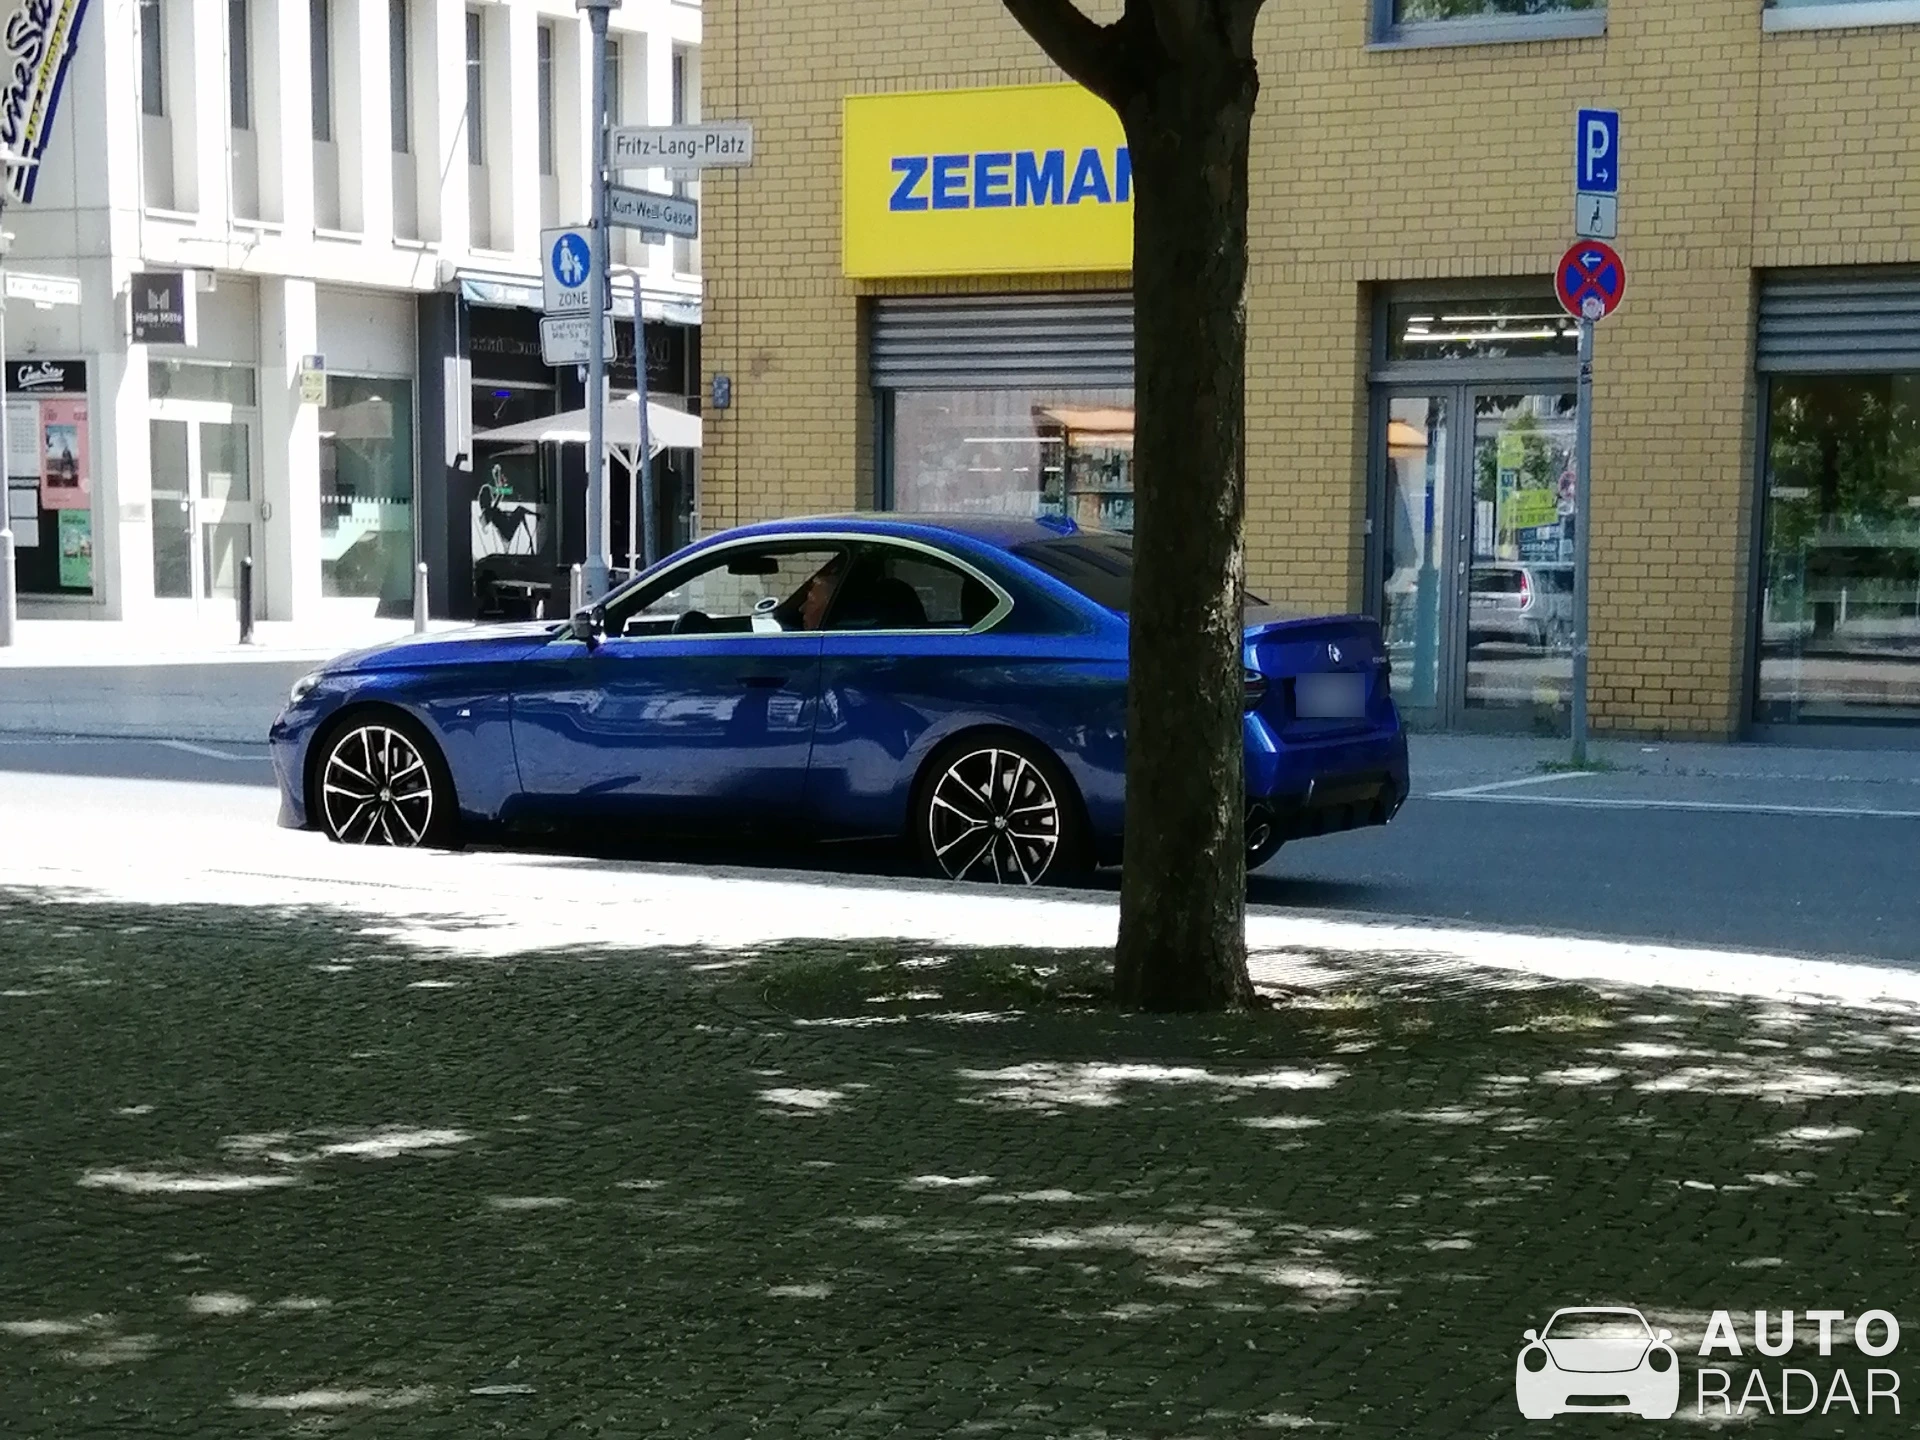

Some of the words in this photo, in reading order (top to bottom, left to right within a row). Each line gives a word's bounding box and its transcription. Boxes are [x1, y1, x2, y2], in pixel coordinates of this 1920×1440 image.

[616, 134, 745, 160] Fritz-Lang-Platz
[1586, 119, 1610, 182] P
[558, 291, 588, 307] ZONE
[135, 312, 158, 323] Helle
